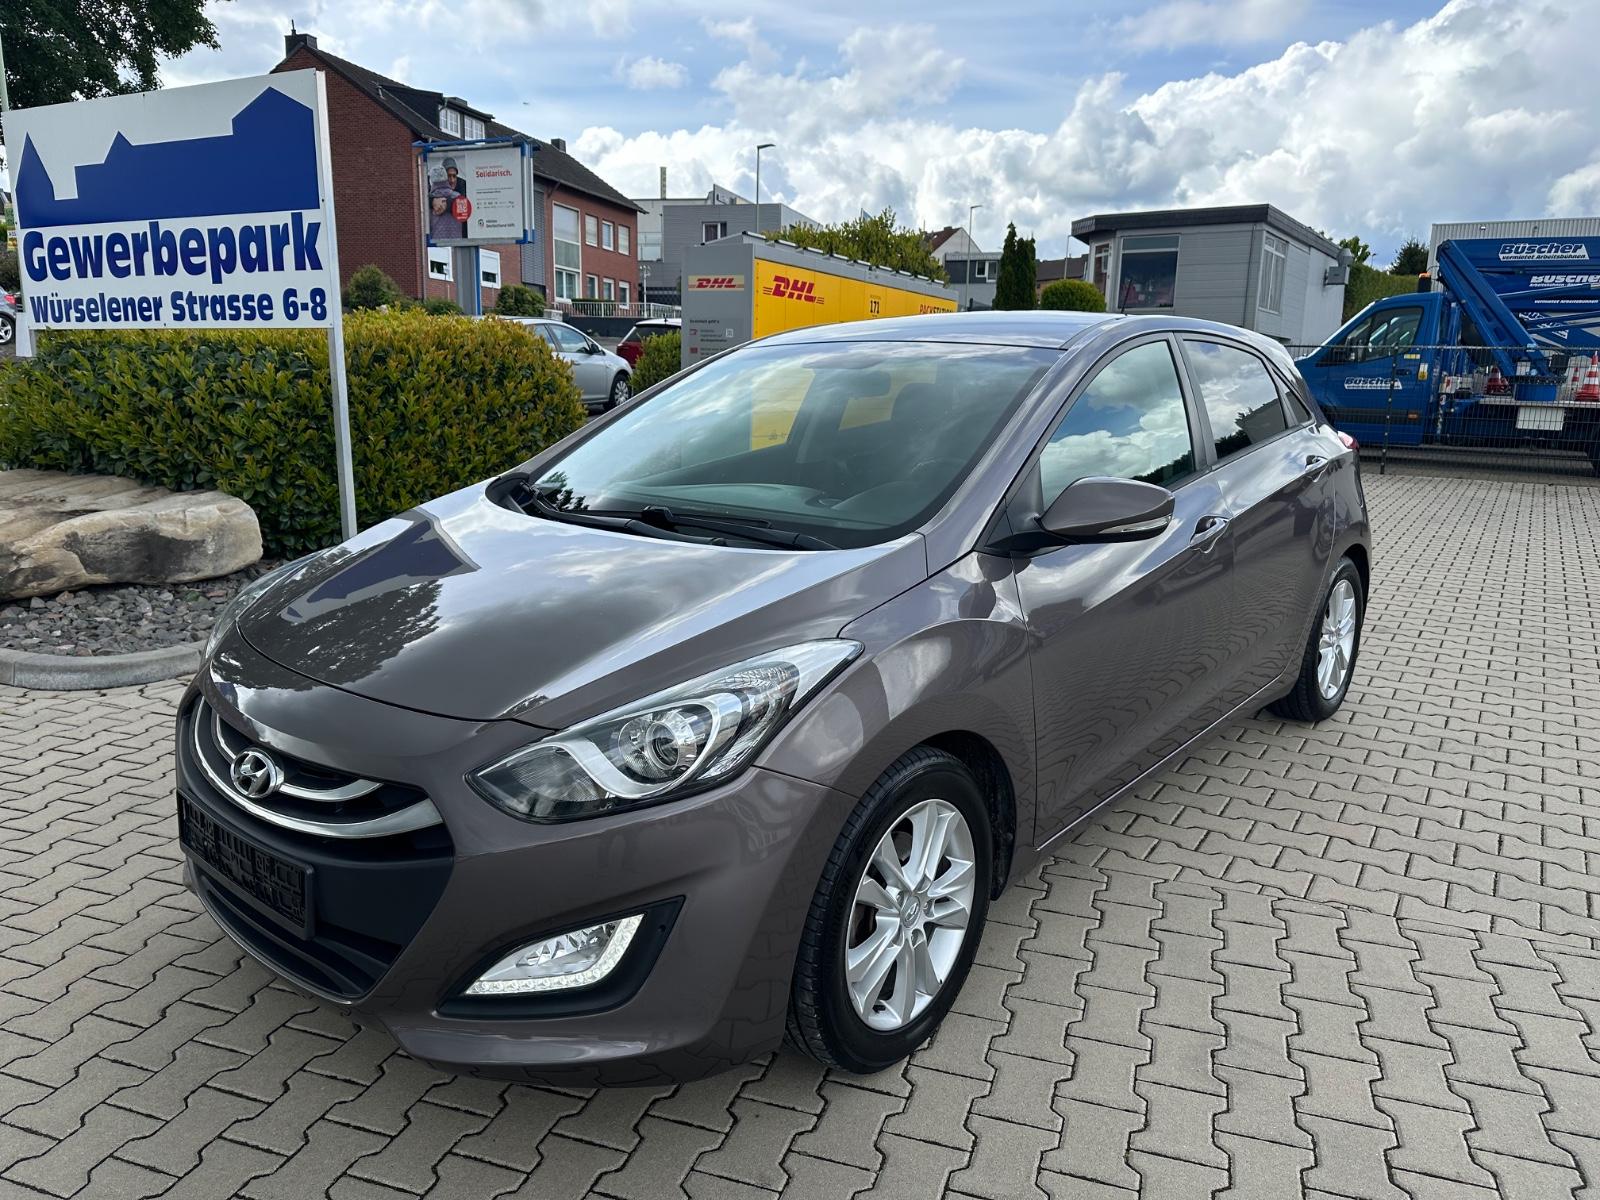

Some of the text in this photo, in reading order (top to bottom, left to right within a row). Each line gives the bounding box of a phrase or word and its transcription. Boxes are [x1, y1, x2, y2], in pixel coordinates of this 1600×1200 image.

[23, 212, 323, 284] Gewerbepark
[1499, 243, 1584, 254] Büscher
[696, 278, 736, 288] DHL
[772, 275, 816, 303] DHL
[30, 287, 327, 323] Würselener Strasse 6-8
